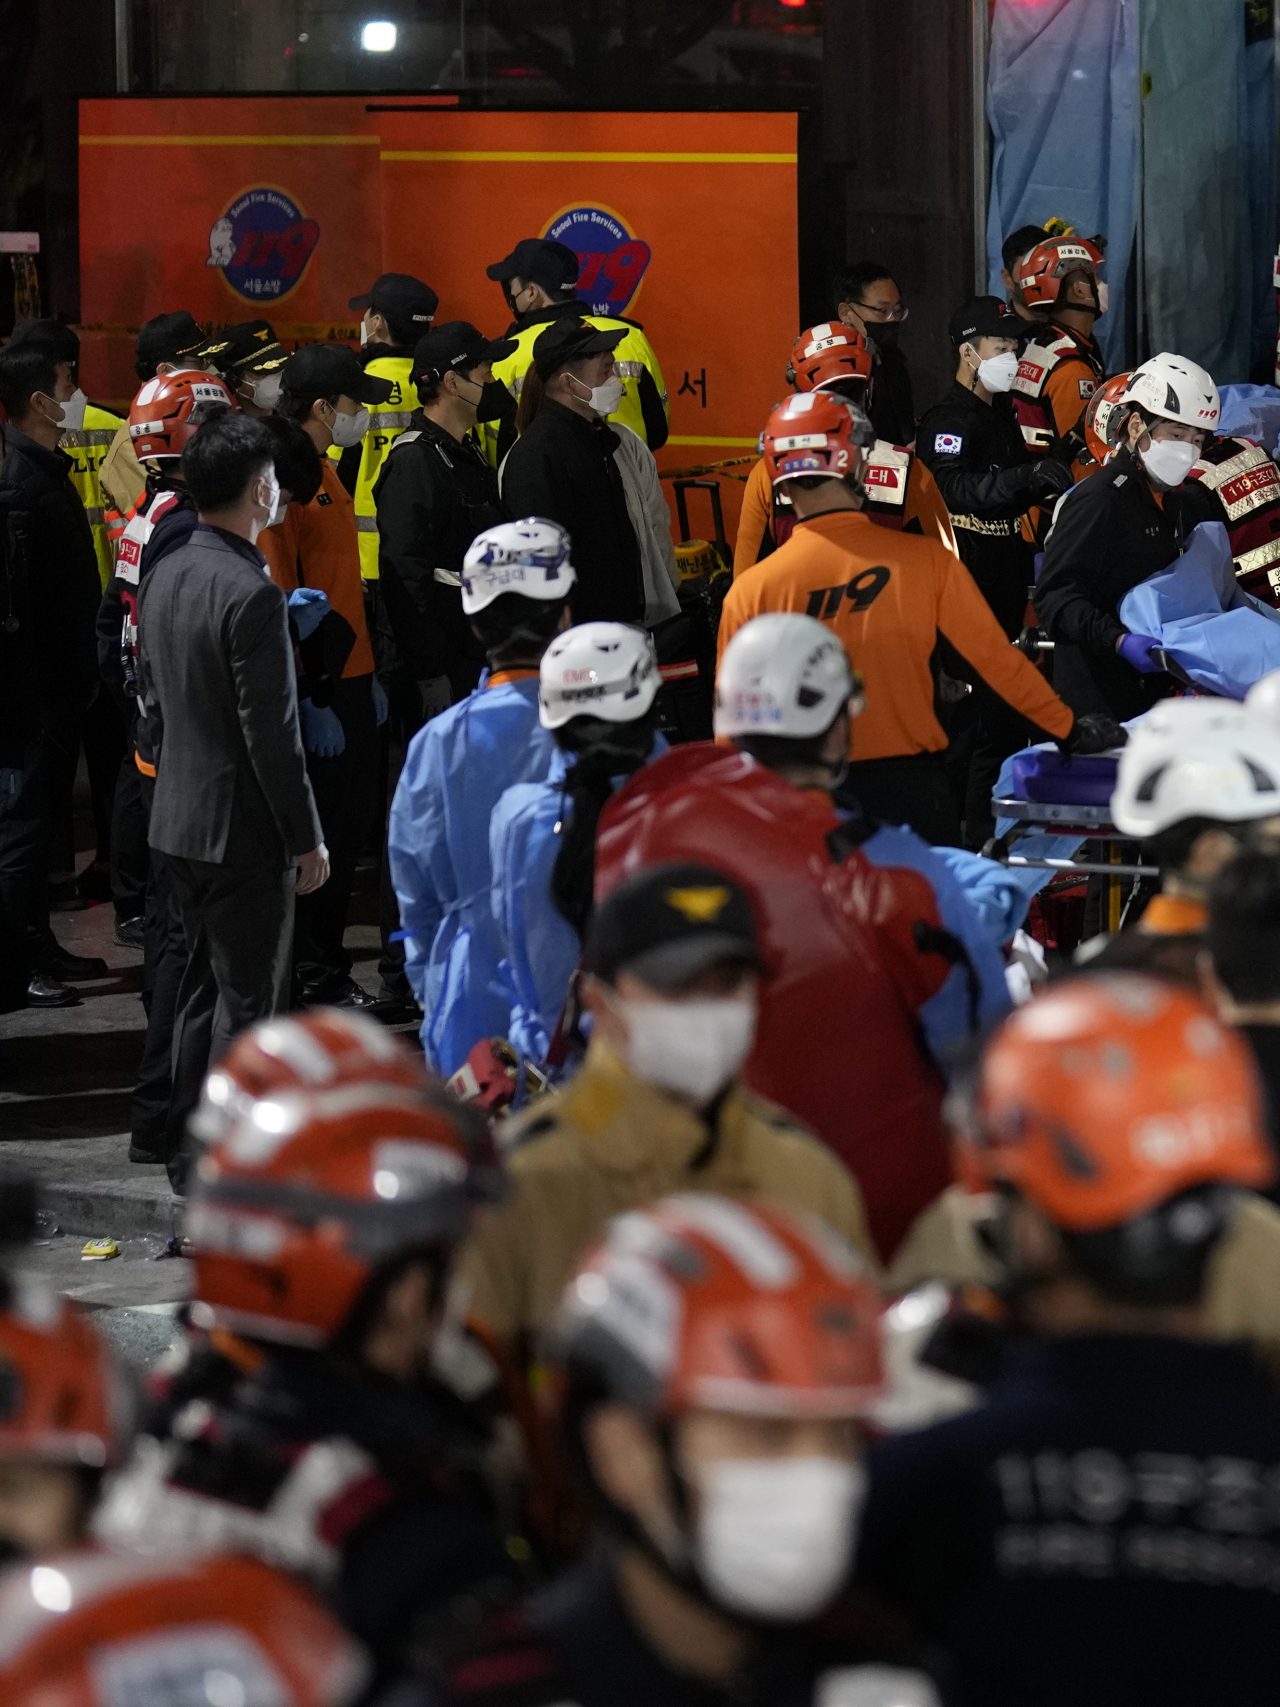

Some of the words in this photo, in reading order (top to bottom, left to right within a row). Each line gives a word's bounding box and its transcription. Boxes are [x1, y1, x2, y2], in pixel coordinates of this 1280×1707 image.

[551, 216, 573, 239] Seoul
[572, 212, 589, 224] Fire
[591, 210, 623, 240] Services
[243, 278, 281, 293] 서울소방
[677, 368, 707, 408] 서
[837, 449, 848, 468] 2
[1228, 466, 1277, 497] 119구조대
[805, 564, 891, 621] 119
